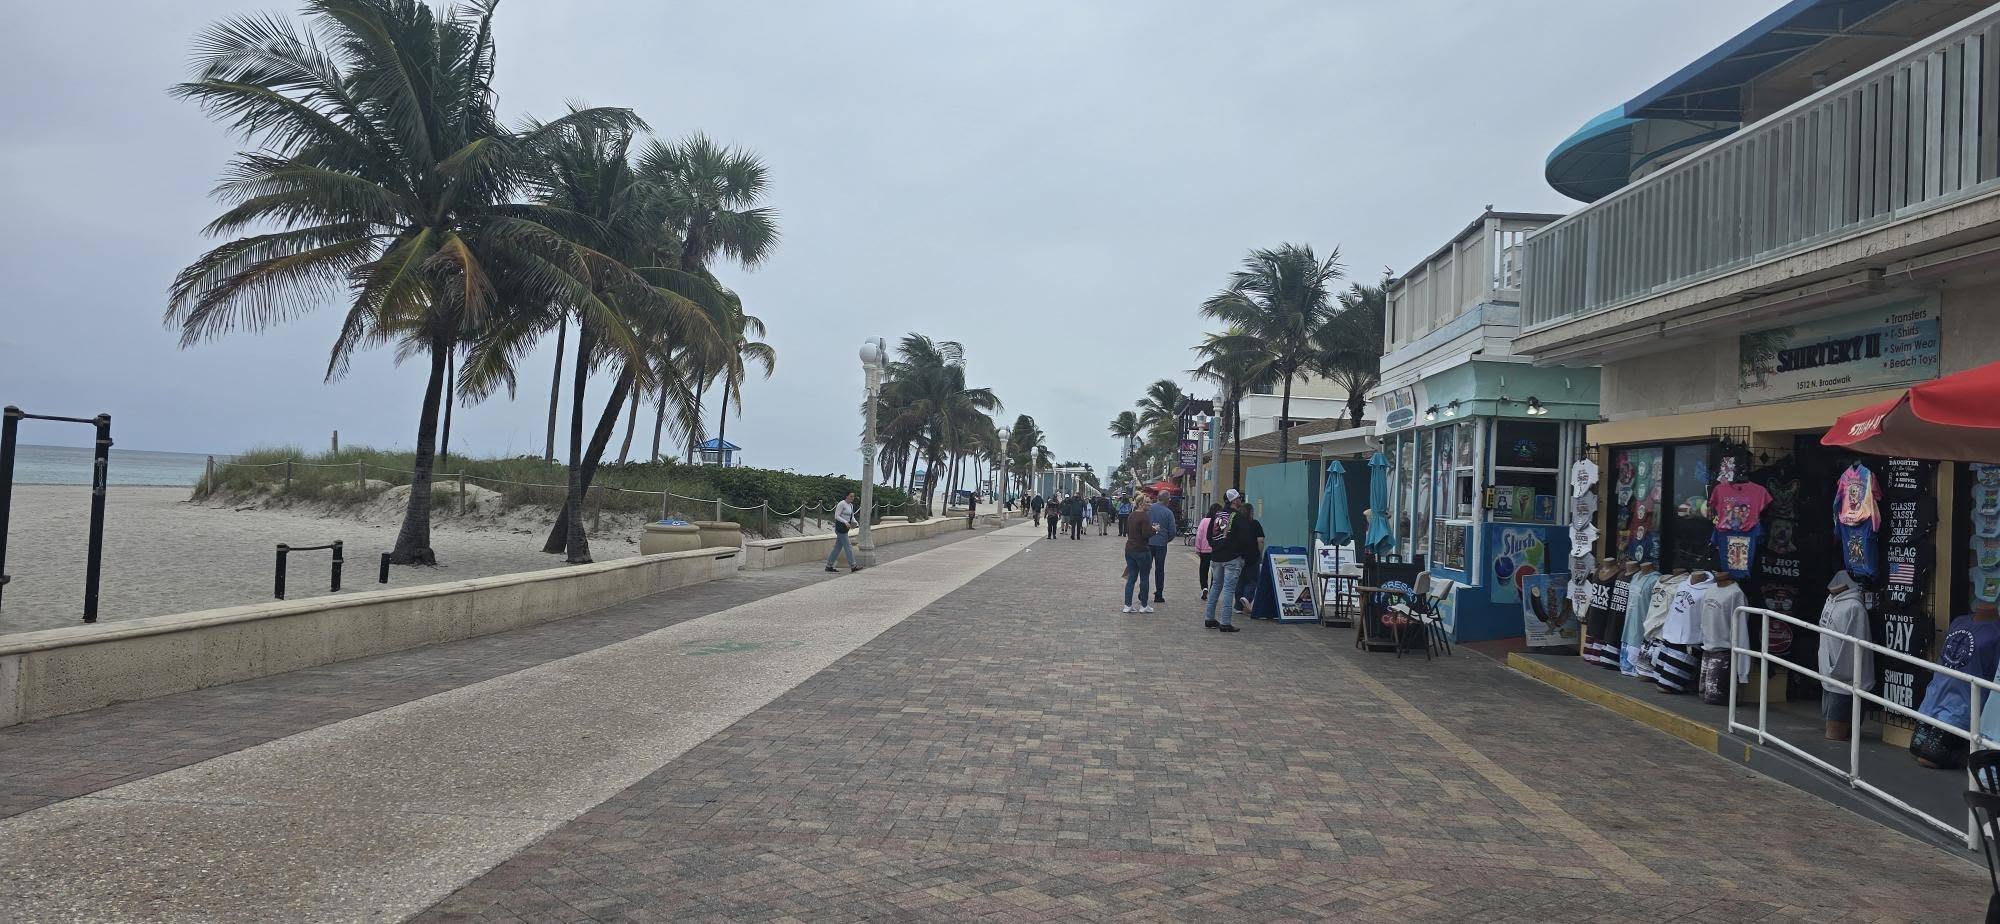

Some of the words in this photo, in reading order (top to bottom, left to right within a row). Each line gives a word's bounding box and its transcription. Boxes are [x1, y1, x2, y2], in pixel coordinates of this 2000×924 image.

[1891, 309, 1927, 324] Transfers
[1890, 326, 1919, 338] T-Shirts
[1777, 335, 1863, 373] SHIRTERY
[1890, 341, 1912, 354] Swim
[1914, 339, 1937, 350] Wear
[1889, 355, 1917, 369] Beach
[1919, 353, 1937, 366] Toys
[1797, 382, 1810, 390] 1512
[1811, 381, 1818, 389] N.
[1819, 375, 1851, 387] Broadwalk
[1891, 502, 1917, 511] CLASSY
[1893, 510, 1914, 519] SASSY
[1897, 519, 1902, 527] A
[1905, 519, 1917, 528] BIT
[1892, 527, 1914, 536] SMART
[1503, 532, 1535, 557] Slush
[1895, 546, 1916, 558] FLAG
[1761, 556, 1766, 564] I
[1776, 558, 1800, 568] HOT
[1761, 565, 1800, 577] MOMS
[1592, 583, 1610, 599] SIX
[1884, 613, 1896, 621] I'M
[1897, 615, 1914, 623] NOT
[1885, 621, 1914, 652] GAY
[1885, 669, 1903, 685] SHUT
[1903, 673, 1914, 687] UP
[1883, 683, 1913, 708] LIVER
